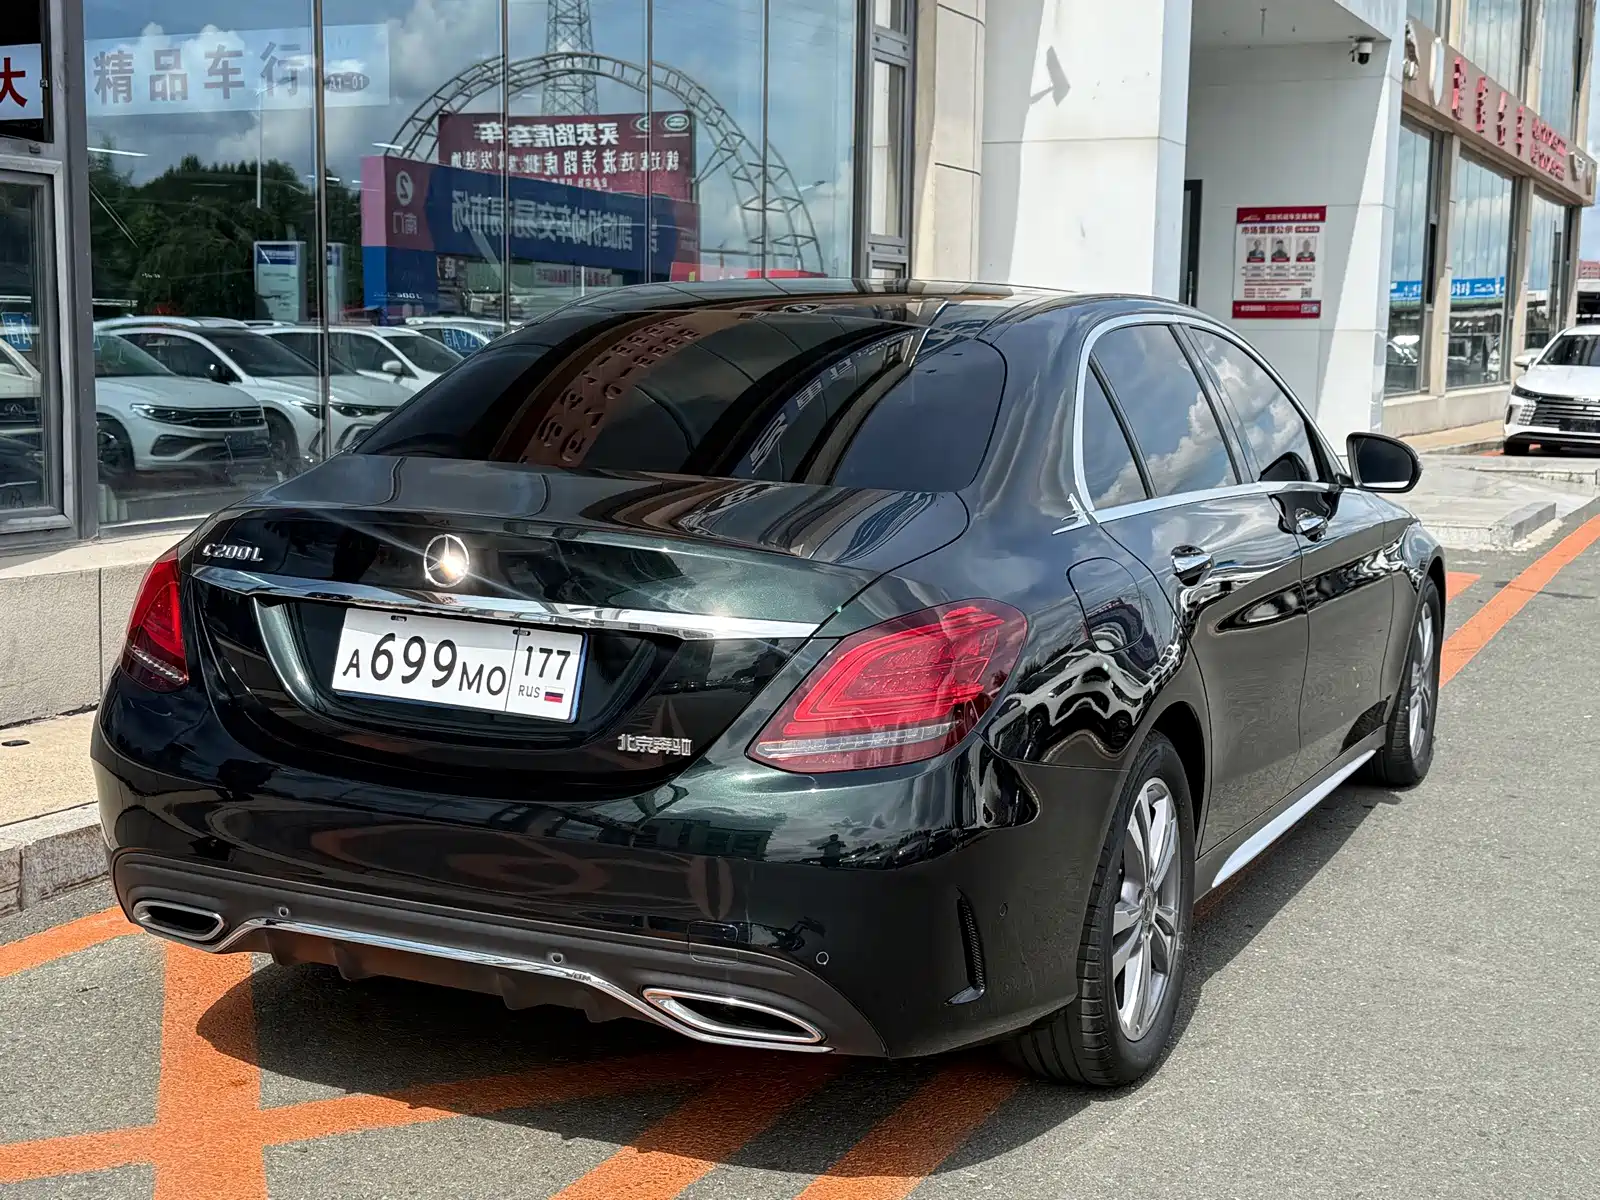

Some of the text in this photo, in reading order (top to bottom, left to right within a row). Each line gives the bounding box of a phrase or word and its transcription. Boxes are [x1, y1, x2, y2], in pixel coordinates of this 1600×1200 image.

[93, 42, 301, 104] 精品车行
[202, 543, 264, 562] C200L
[524, 645, 571, 680] 177
[518, 684, 541, 698] RUS
